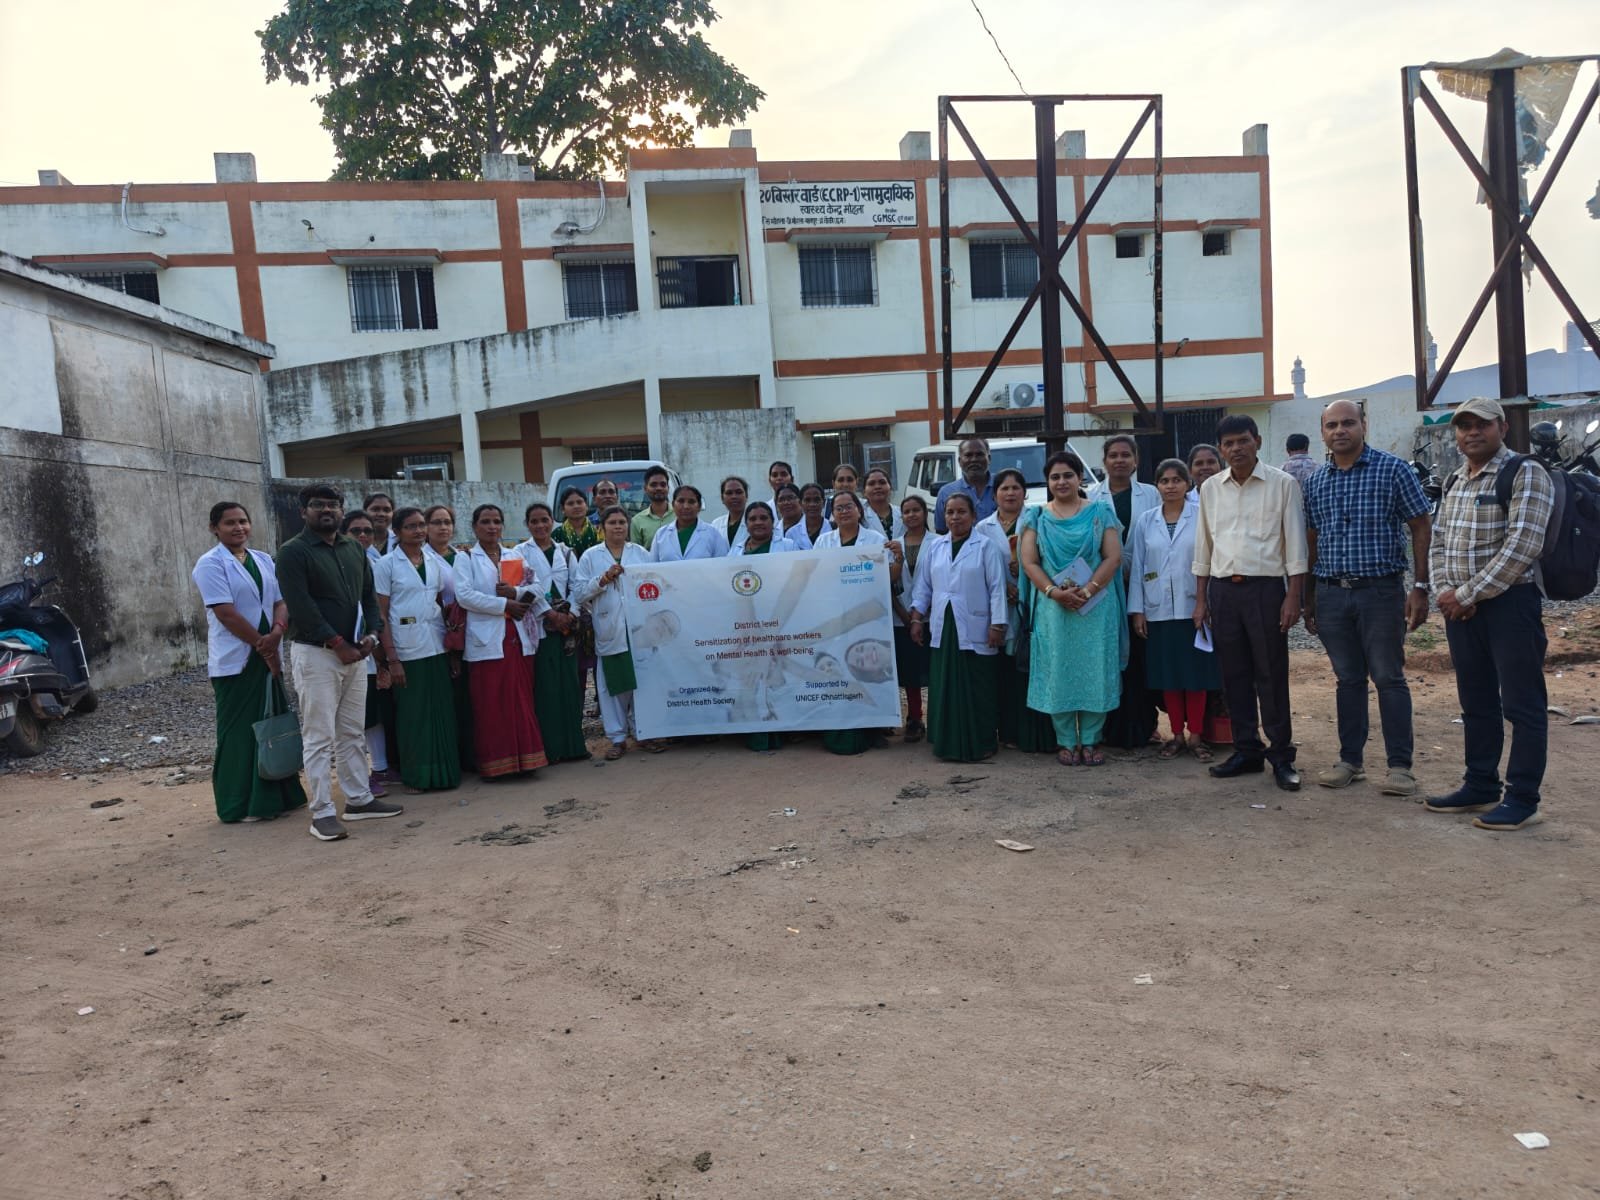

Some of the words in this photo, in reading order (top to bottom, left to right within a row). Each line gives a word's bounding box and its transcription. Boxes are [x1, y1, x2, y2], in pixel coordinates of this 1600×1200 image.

[873, 214, 895, 223] CGMSC
[840, 562, 863, 573] unicef
[762, 620, 778, 628] level
[695, 637, 741, 647] Sensitization
[752, 634, 791, 643] healthcare
[717, 651, 741, 659] Mental
[743, 648, 768, 657] Health
[769, 648, 775, 656] &
[777, 647, 814, 655] well-being
[840, 680, 849, 688] by
[679, 686, 711, 695] Organized
[666, 700, 690, 708] District
[690, 698, 712, 706] Health
[712, 697, 736, 705] Society
[795, 694, 820, 702] UNICEF
